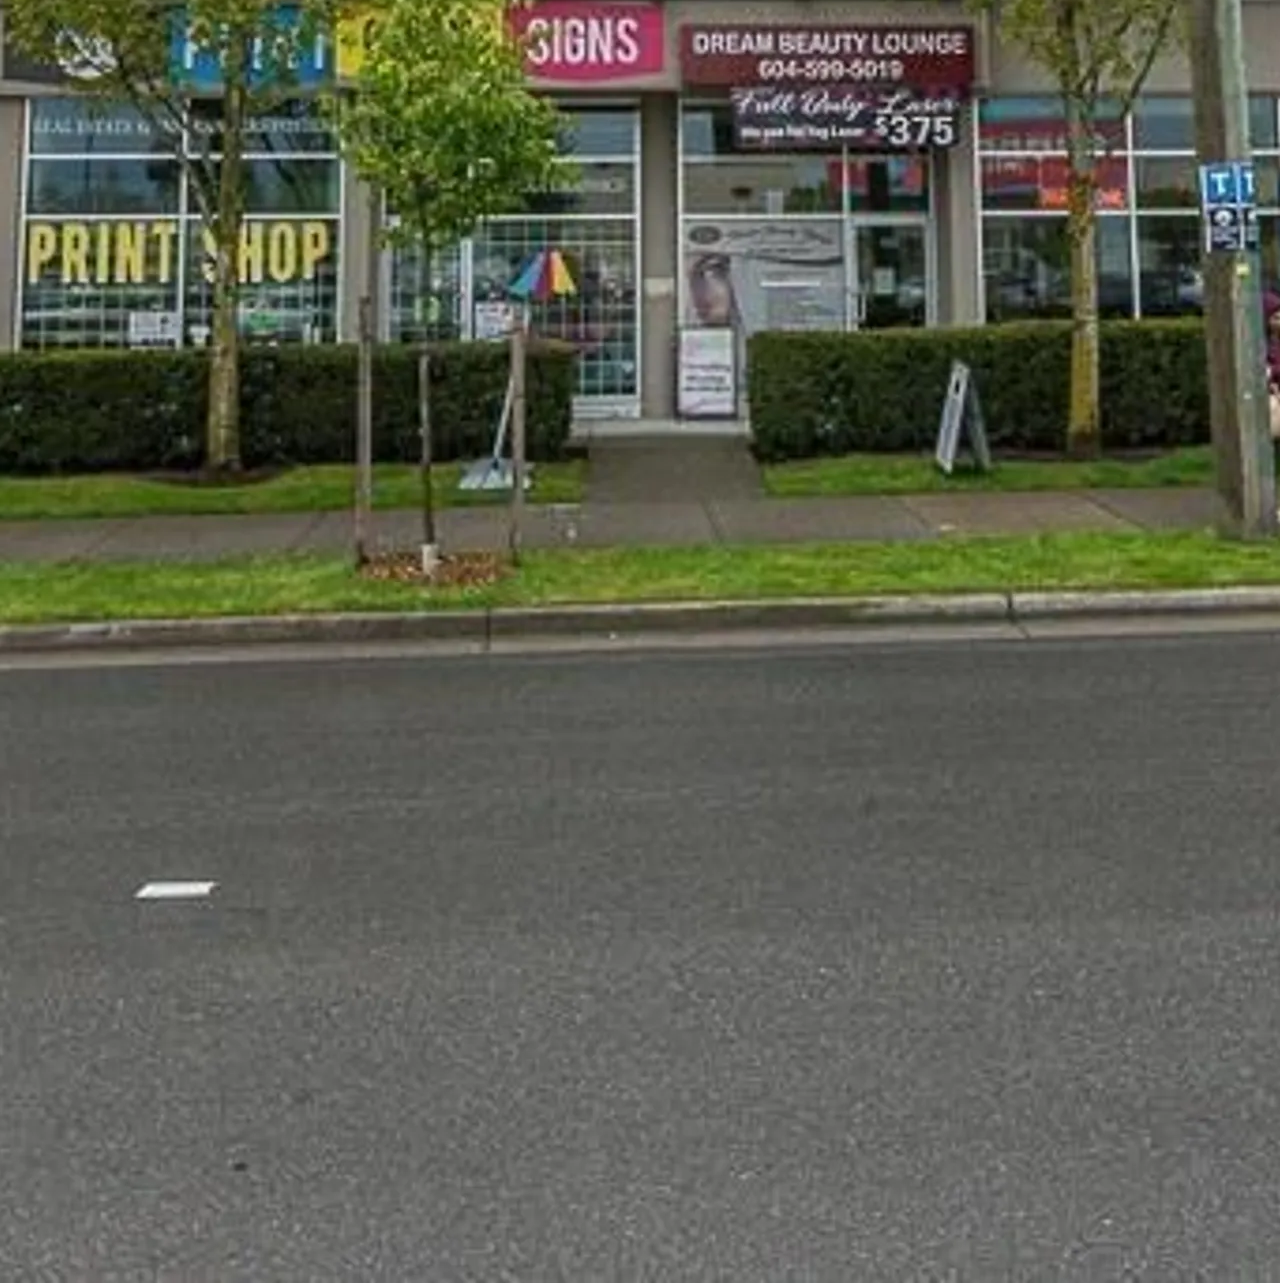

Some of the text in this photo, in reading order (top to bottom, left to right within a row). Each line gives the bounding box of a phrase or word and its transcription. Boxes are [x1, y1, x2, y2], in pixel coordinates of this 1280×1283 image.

[527, 17, 640, 66] SIGNS
[693, 32, 968, 55] DREAM BEAUTY LOUNGE
[874, 115, 955, 146] $375
[27, 221, 177, 284] PRINT
